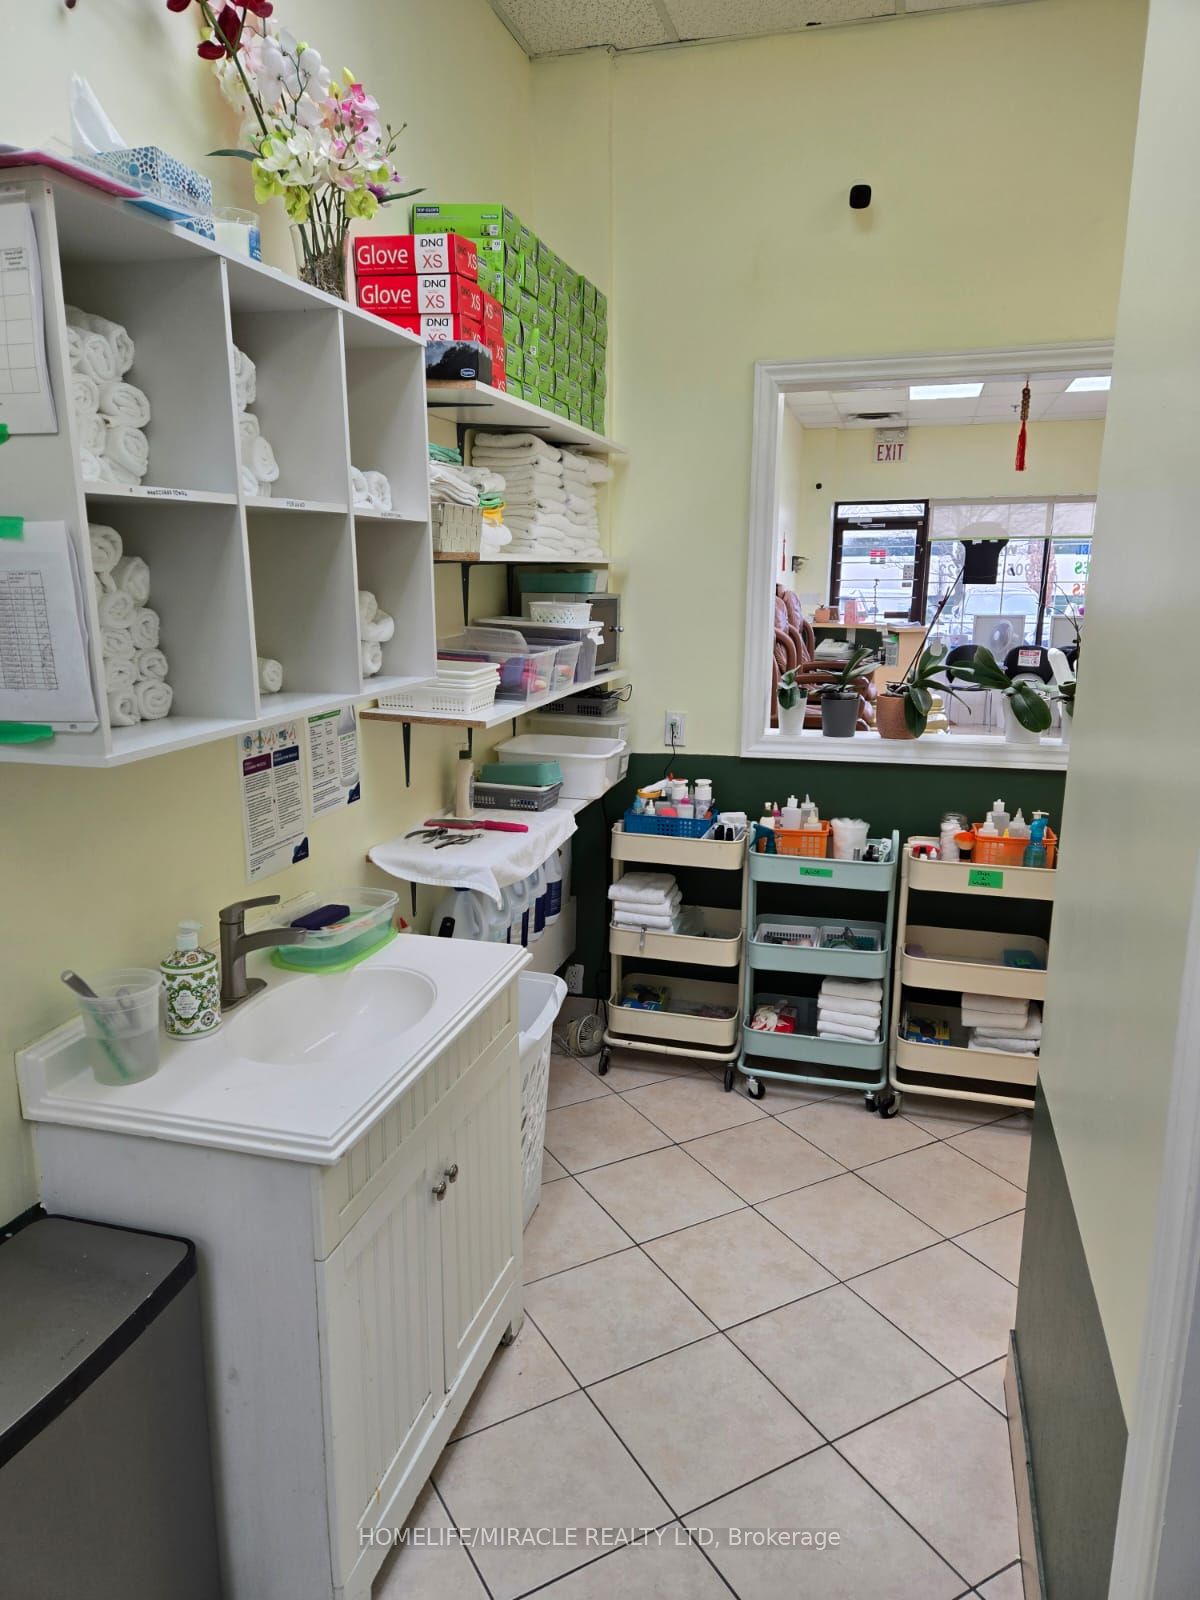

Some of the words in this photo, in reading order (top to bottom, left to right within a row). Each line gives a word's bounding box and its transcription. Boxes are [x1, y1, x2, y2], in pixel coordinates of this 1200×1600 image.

[420, 238, 444, 248] DND
[357, 244, 409, 265] Glove
[422, 254, 443, 269] XS
[467, 252, 477, 270] XS
[424, 279, 446, 288] DND
[361, 284, 412, 304] Glove
[425, 294, 445, 309] XS
[471, 292, 480, 311] XS
[426, 318, 449, 327] DND
[876, 443, 905, 462] EXIT
